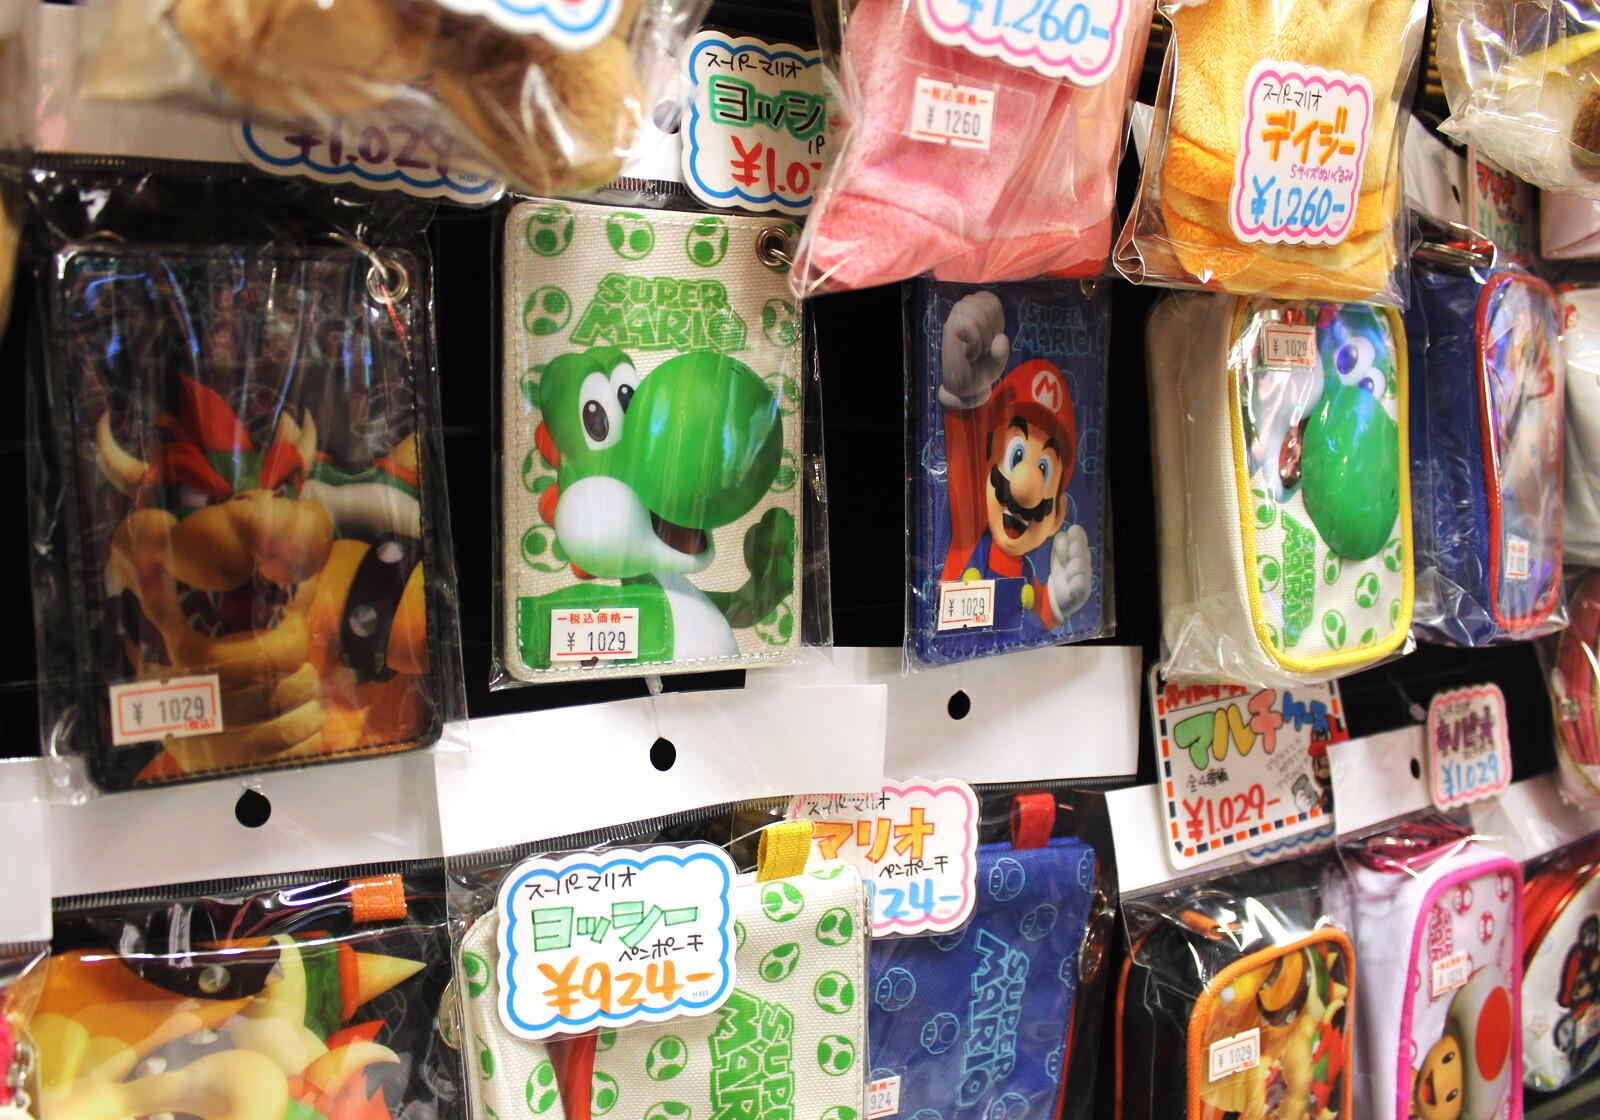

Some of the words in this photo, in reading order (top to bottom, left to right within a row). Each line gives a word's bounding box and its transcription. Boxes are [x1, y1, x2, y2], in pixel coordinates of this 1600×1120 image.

[706, 52, 803, 78] スーパーマリオ
[1263, 83, 1323, 111] スーパーマリオ
[945, 108, 981, 136] 1260
[730, 134, 824, 194] ¥1.0
[598, 273, 729, 309] SUPER
[570, 301, 748, 352] MARIO
[1023, 302, 1083, 328] SUPER
[1011, 323, 1092, 356] MARIO
[569, 612, 621, 625] 税込価格
[948, 598, 955, 617] ¥
[961, 597, 985, 616] 1029
[567, 631, 576, 651] ¥
[587, 631, 626, 652] 1029
[132, 701, 143, 726] ¥
[157, 695, 205, 723] 1029
[1182, 783, 1282, 842] ¥1.029-
[812, 807, 935, 864] マリオ
[525, 866, 637, 901] スーパーマリオ
[531, 900, 699, 953] ヨッシー
[536, 954, 716, 1019] ¥924-
[957, 928, 1009, 1108] MARIO
[992, 948, 1031, 1080] SUPER
